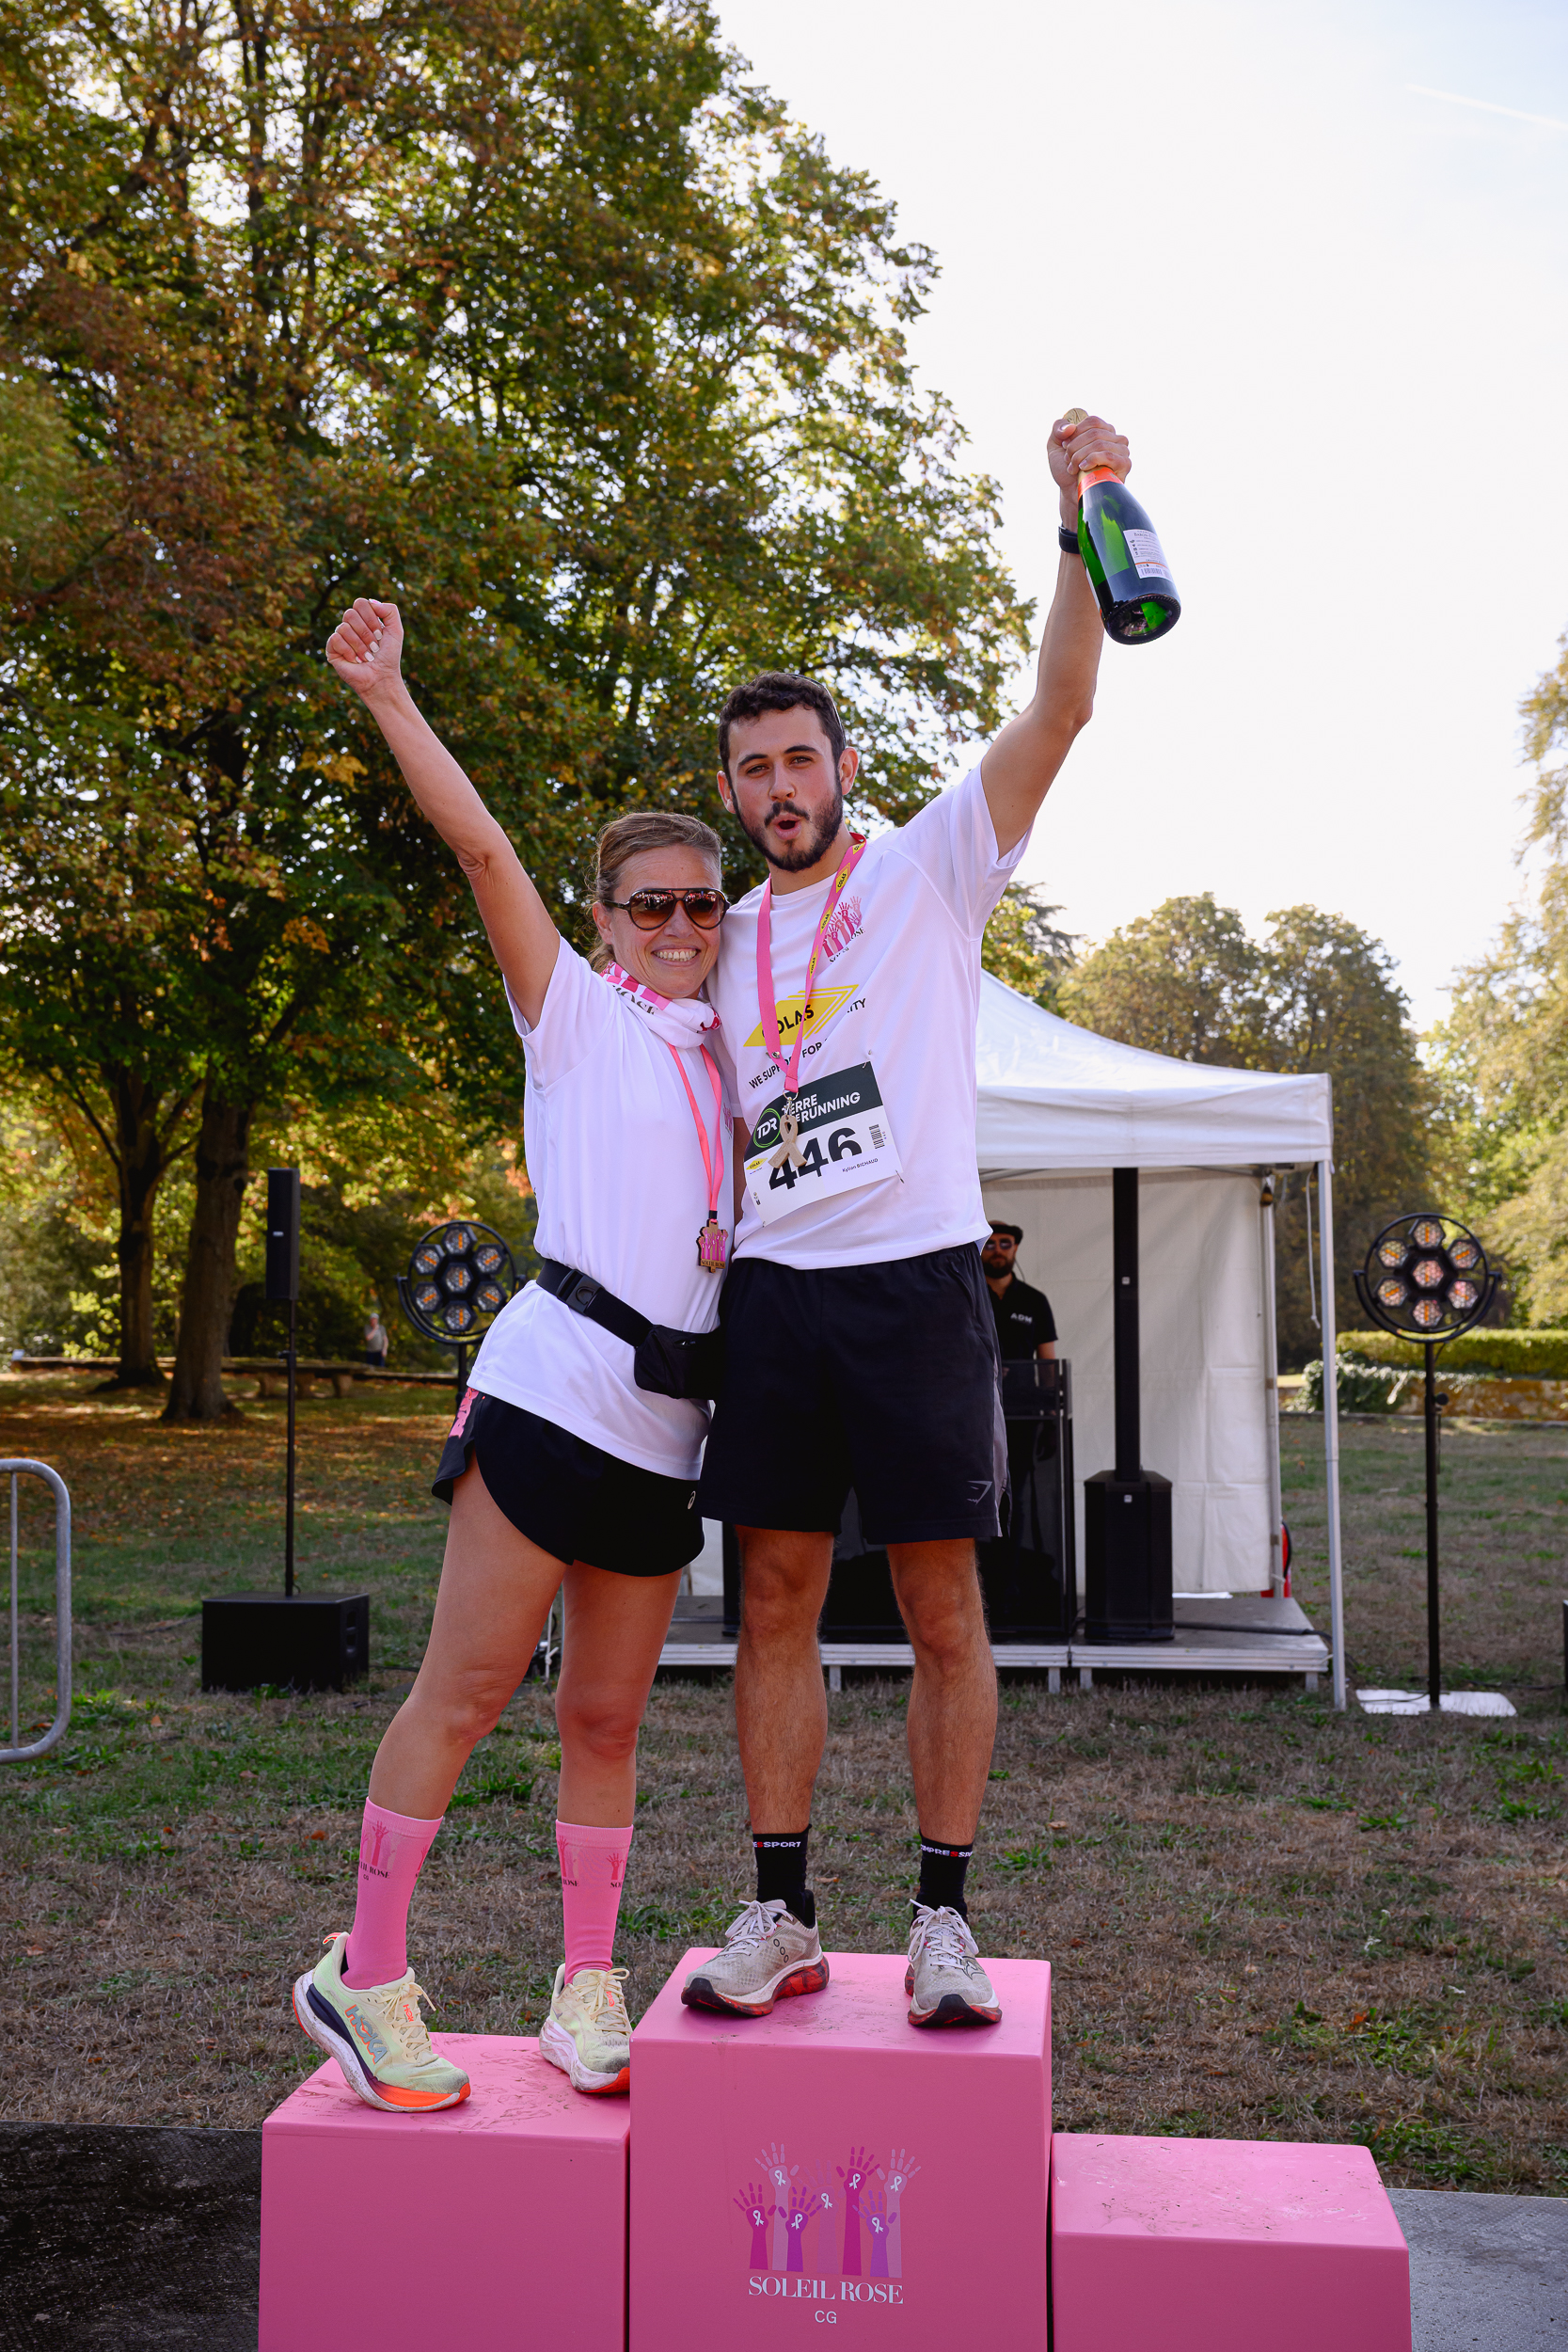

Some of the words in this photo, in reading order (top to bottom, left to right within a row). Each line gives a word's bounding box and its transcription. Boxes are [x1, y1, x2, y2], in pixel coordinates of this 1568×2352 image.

[837, 872, 847, 889] COLAS
[761, 1004, 815, 1039] OLAS
[749, 1074, 764, 1089] WE
[800, 1091, 861, 1123] RUNNING
[756, 1117, 779, 1140] TDR
[768, 1127, 863, 1191] 446
[369, 1866, 391, 1880] ROSE
[403, 2003, 415, 2023] HOK
[344, 2004, 388, 2065] HOKA
[748, 2276, 836, 2300] SOLEIL
[839, 2280, 904, 2305] ROSE
[815, 2310, 837, 2325] CG
